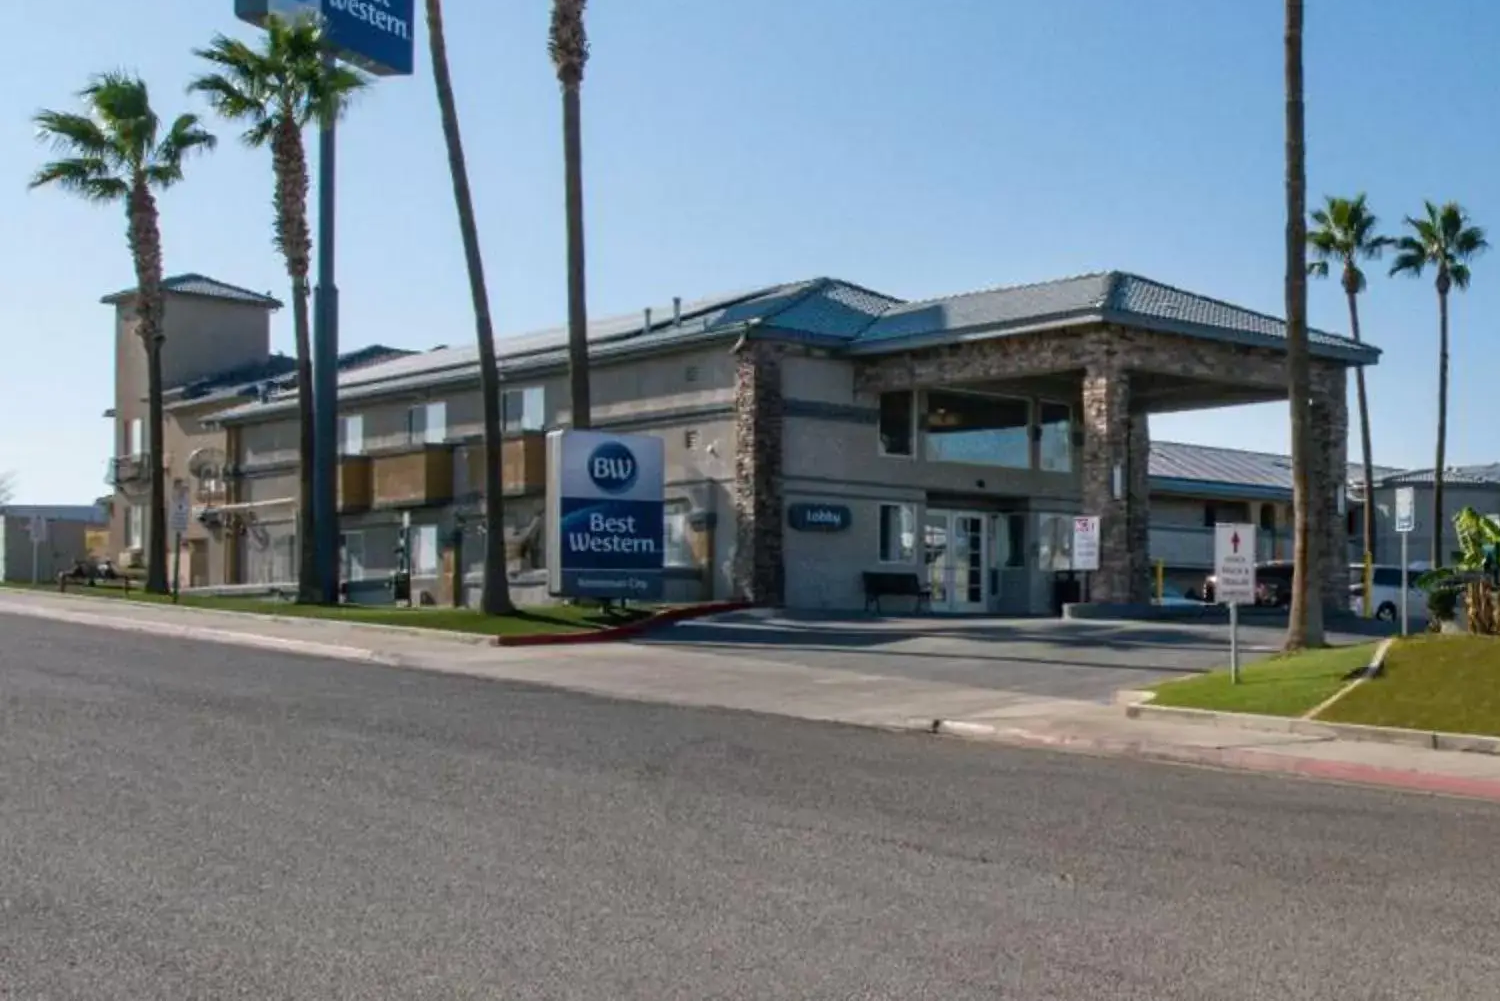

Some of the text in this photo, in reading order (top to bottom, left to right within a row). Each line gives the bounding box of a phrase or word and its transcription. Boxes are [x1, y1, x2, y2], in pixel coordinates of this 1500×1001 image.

[593, 457, 633, 480] BW
[589, 512, 636, 534] Best
[806, 509, 841, 526] Lobby
[568, 531, 655, 553] Western
